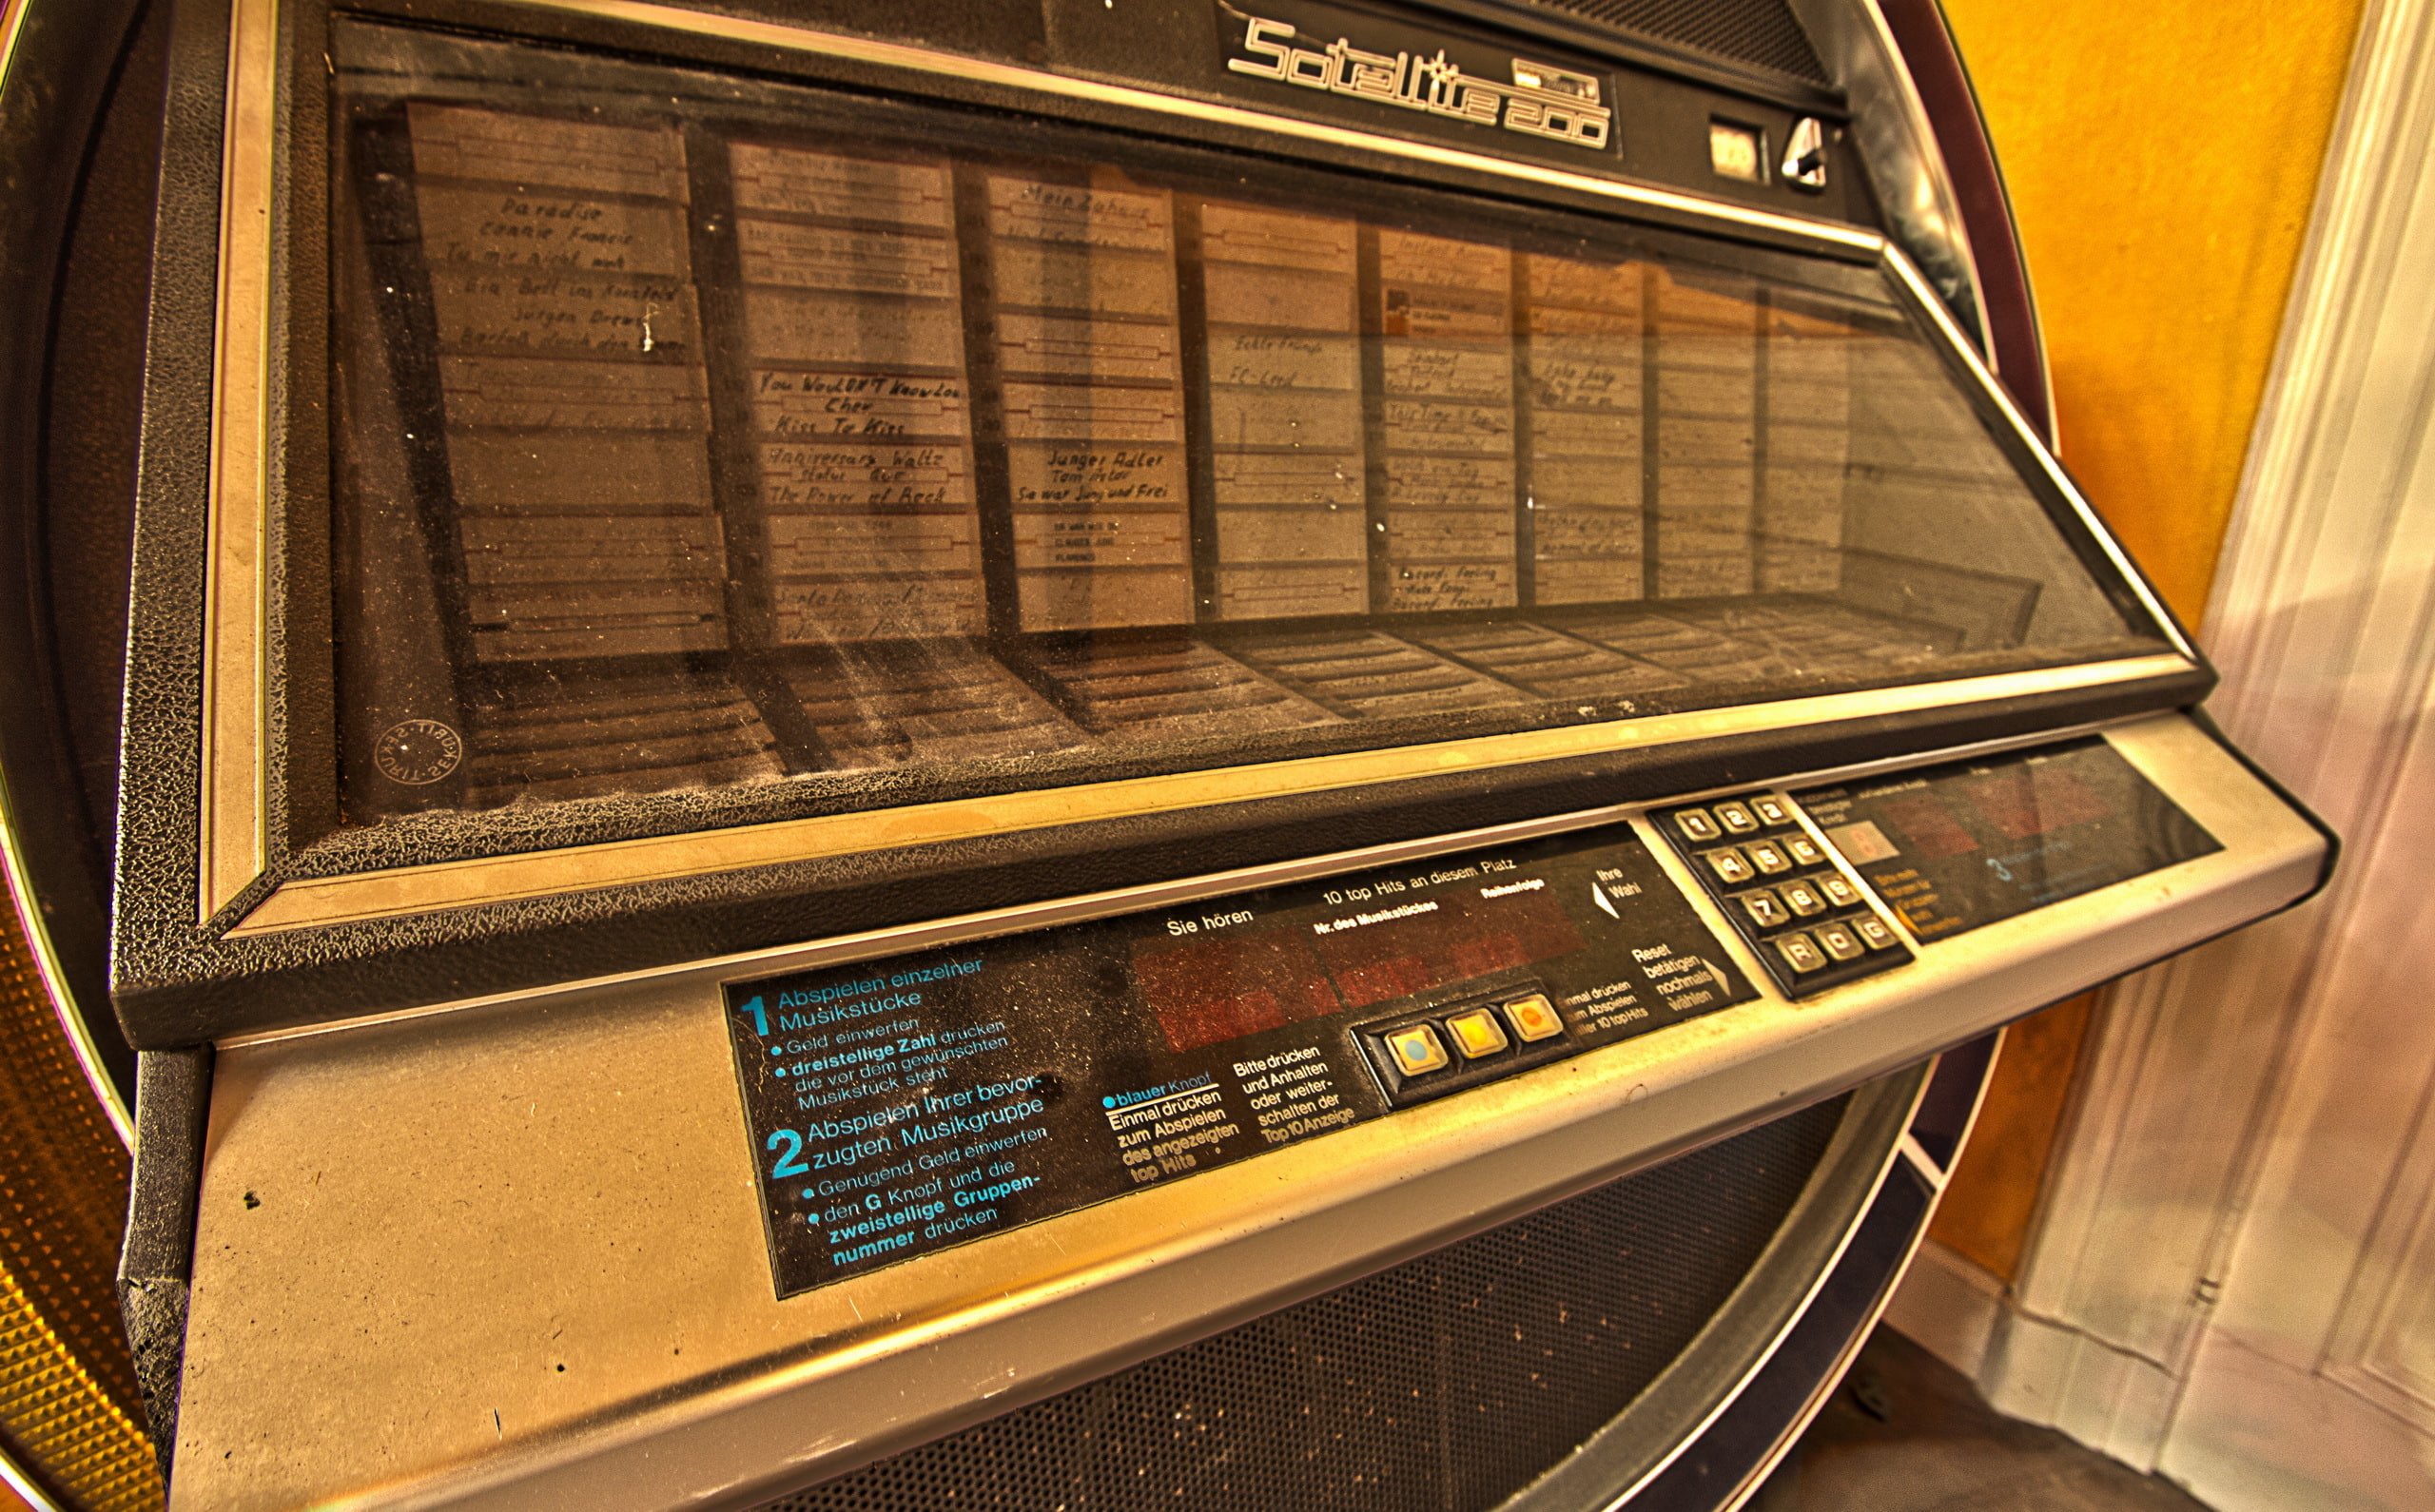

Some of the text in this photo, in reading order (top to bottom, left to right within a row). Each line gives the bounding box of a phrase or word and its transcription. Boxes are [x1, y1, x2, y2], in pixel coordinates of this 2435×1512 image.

[1504, 97, 1609, 149] 200
[1688, 803, 1782, 832] 1 2 3
[1596, 867, 1625, 882] Ihre
[1722, 841, 1815, 872] 4 5 6
[1323, 858, 1518, 905] 10 top Hits an diesem Platz
[1608, 882, 1643, 900] Wahl
[1754, 880, 1849, 916] 7 8 9
[1167, 907, 1255, 937] Sie hören
[1631, 943, 1672, 963] Reset
[1788, 942, 1813, 961] R
[1862, 921, 1885, 939] G
[1642, 955, 1702, 979] betätigen
[1656, 970, 1714, 996] nochmals
[741, 959, 984, 1036] 1 Abspielen einzelner
[779, 992, 922, 1033] Musikstücke
[1588, 995, 1638, 1017] Abspielen
[1666, 990, 1714, 1012] wählen
[787, 1018, 920, 1055] Geld einwerfen
[1596, 1016, 1611, 1029] 10
[1609, 1012, 1628, 1025] top
[1626, 1007, 1649, 1021] Hits
[791, 1020, 1006, 1076] dreistellige Zahl drücken
[795, 1037, 1008, 1093] die vor dem gewünschten
[1233, 1045, 1321, 1078] Bitte drücken
[797, 1067, 948, 1111] Musikstück steht
[1115, 1071, 1213, 1108] blauer Knopf
[1242, 1060, 1329, 1095] und Anhalten
[1250, 1078, 1334, 1111] oder weiter-
[767, 1073, 1042, 1179] 2 Abspielen Ihrer bevor-
[1108, 1090, 1222, 1132] Einmal drücken
[1117, 1108, 1227, 1149] zum Abspielen
[1257, 1093, 1340, 1127] schalten der
[1260, 1107, 1356, 1145] Top 10 Anzeige
[812, 1096, 1045, 1173] zugten Musikgruppe
[1122, 1122, 1240, 1167] des angezeigten
[818, 1125, 1048, 1197] Genügend Geld einwerfen
[1130, 1153, 1197, 1184] top Hits
[824, 1158, 1015, 1224] den G Knopf und die
[828, 1175, 1042, 1244] zweistellige Gruppen-
[832, 1208, 999, 1267] nummer drücken
